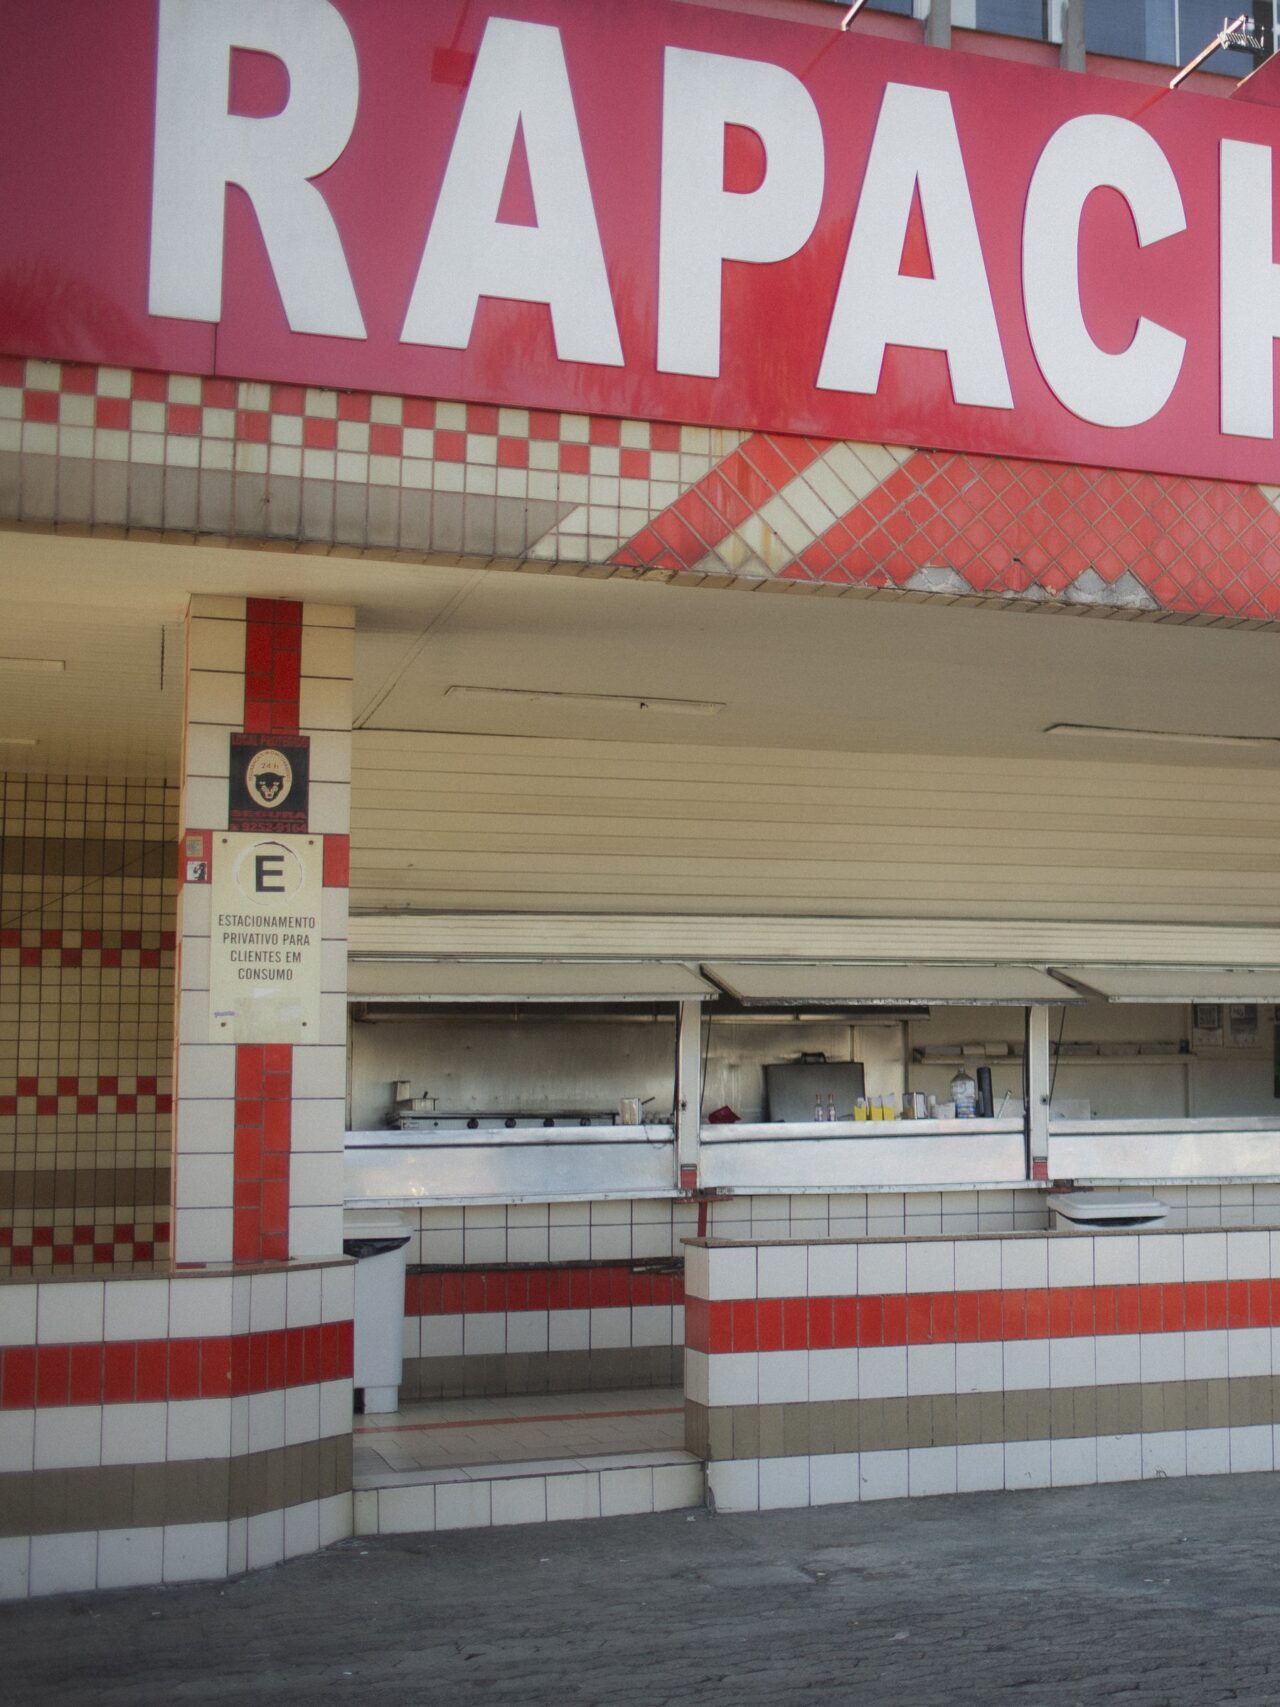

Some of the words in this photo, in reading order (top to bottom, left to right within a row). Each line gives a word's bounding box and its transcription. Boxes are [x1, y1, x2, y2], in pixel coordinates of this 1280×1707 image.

[255, 855, 285, 892] E
[218, 914, 316, 929] ESTACIONAMENTO
[223, 932, 279, 946] PRIVATIVO
[282, 933, 310, 946] PARA
[230, 949, 282, 963] CLIENTES
[286, 951, 302, 964] EM
[238, 967, 294, 981] CONSUMO
